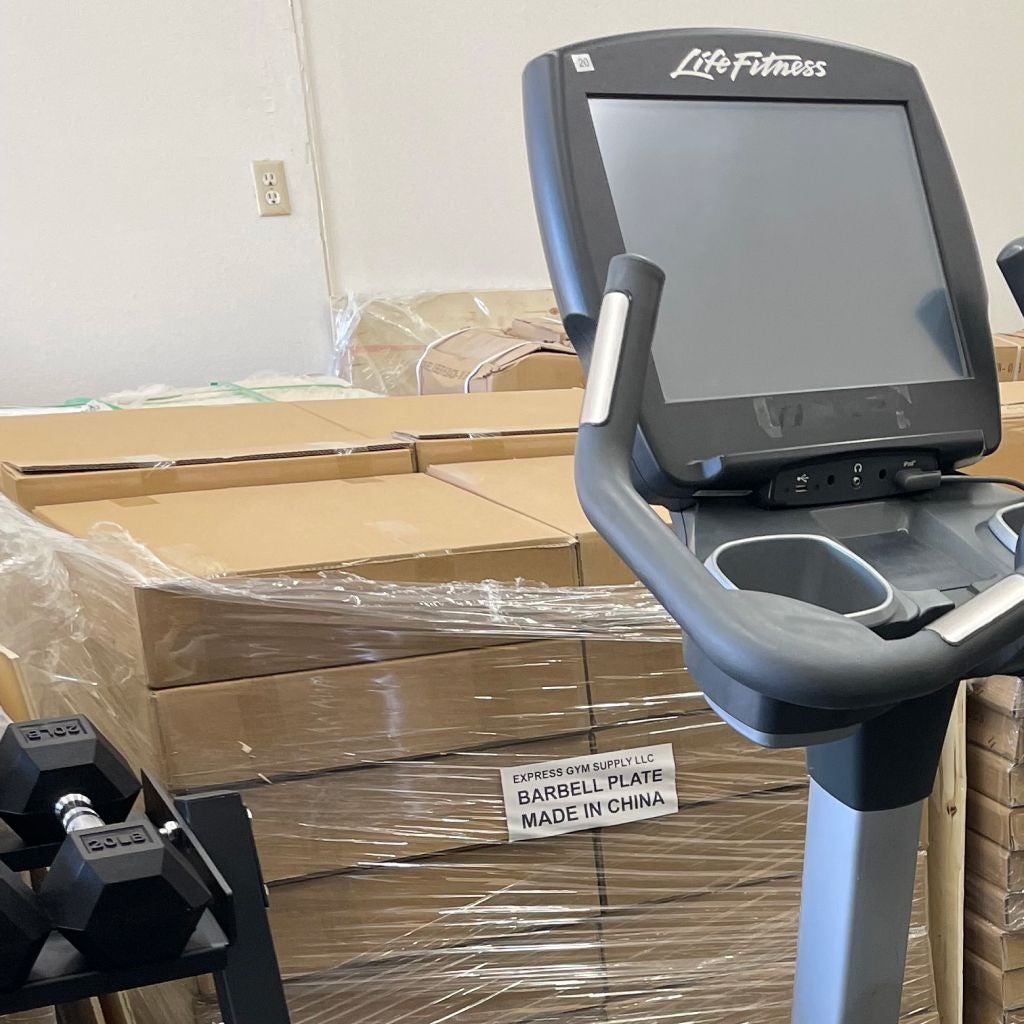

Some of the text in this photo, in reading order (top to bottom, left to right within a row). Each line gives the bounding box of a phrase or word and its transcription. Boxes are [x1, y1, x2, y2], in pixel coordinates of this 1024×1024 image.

[670, 47, 827, 83] Life Fitness
[27, 723, 81, 741] 20LB
[512, 753, 655, 784] EXPRESS GYM SUPPLY LLC
[517, 768, 663, 805] BARBELL PLATE
[521, 791, 665, 829] MADE IN CHINA
[88, 831, 146, 851] 20LB
